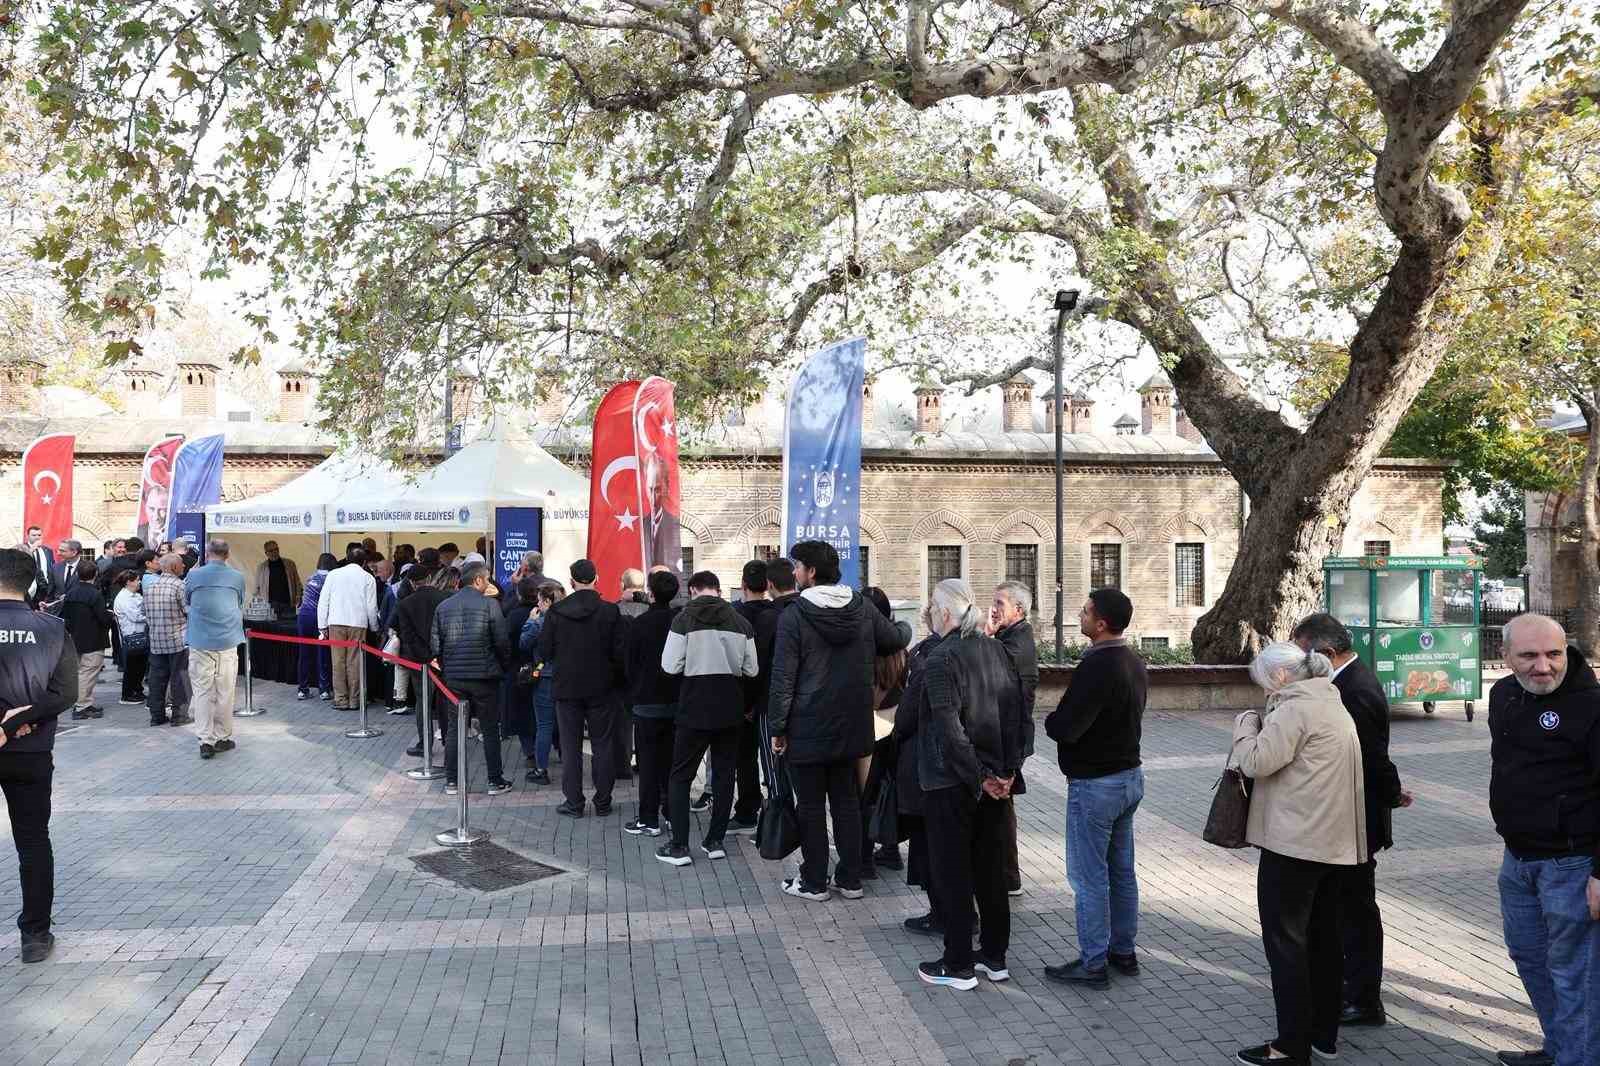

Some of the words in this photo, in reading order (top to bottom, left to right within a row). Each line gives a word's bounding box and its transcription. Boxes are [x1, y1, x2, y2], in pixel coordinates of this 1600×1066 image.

[348, 511, 369, 521] BURSA
[414, 508, 455, 521] BELEDİYESİ
[796, 525, 850, 538] BURSA
